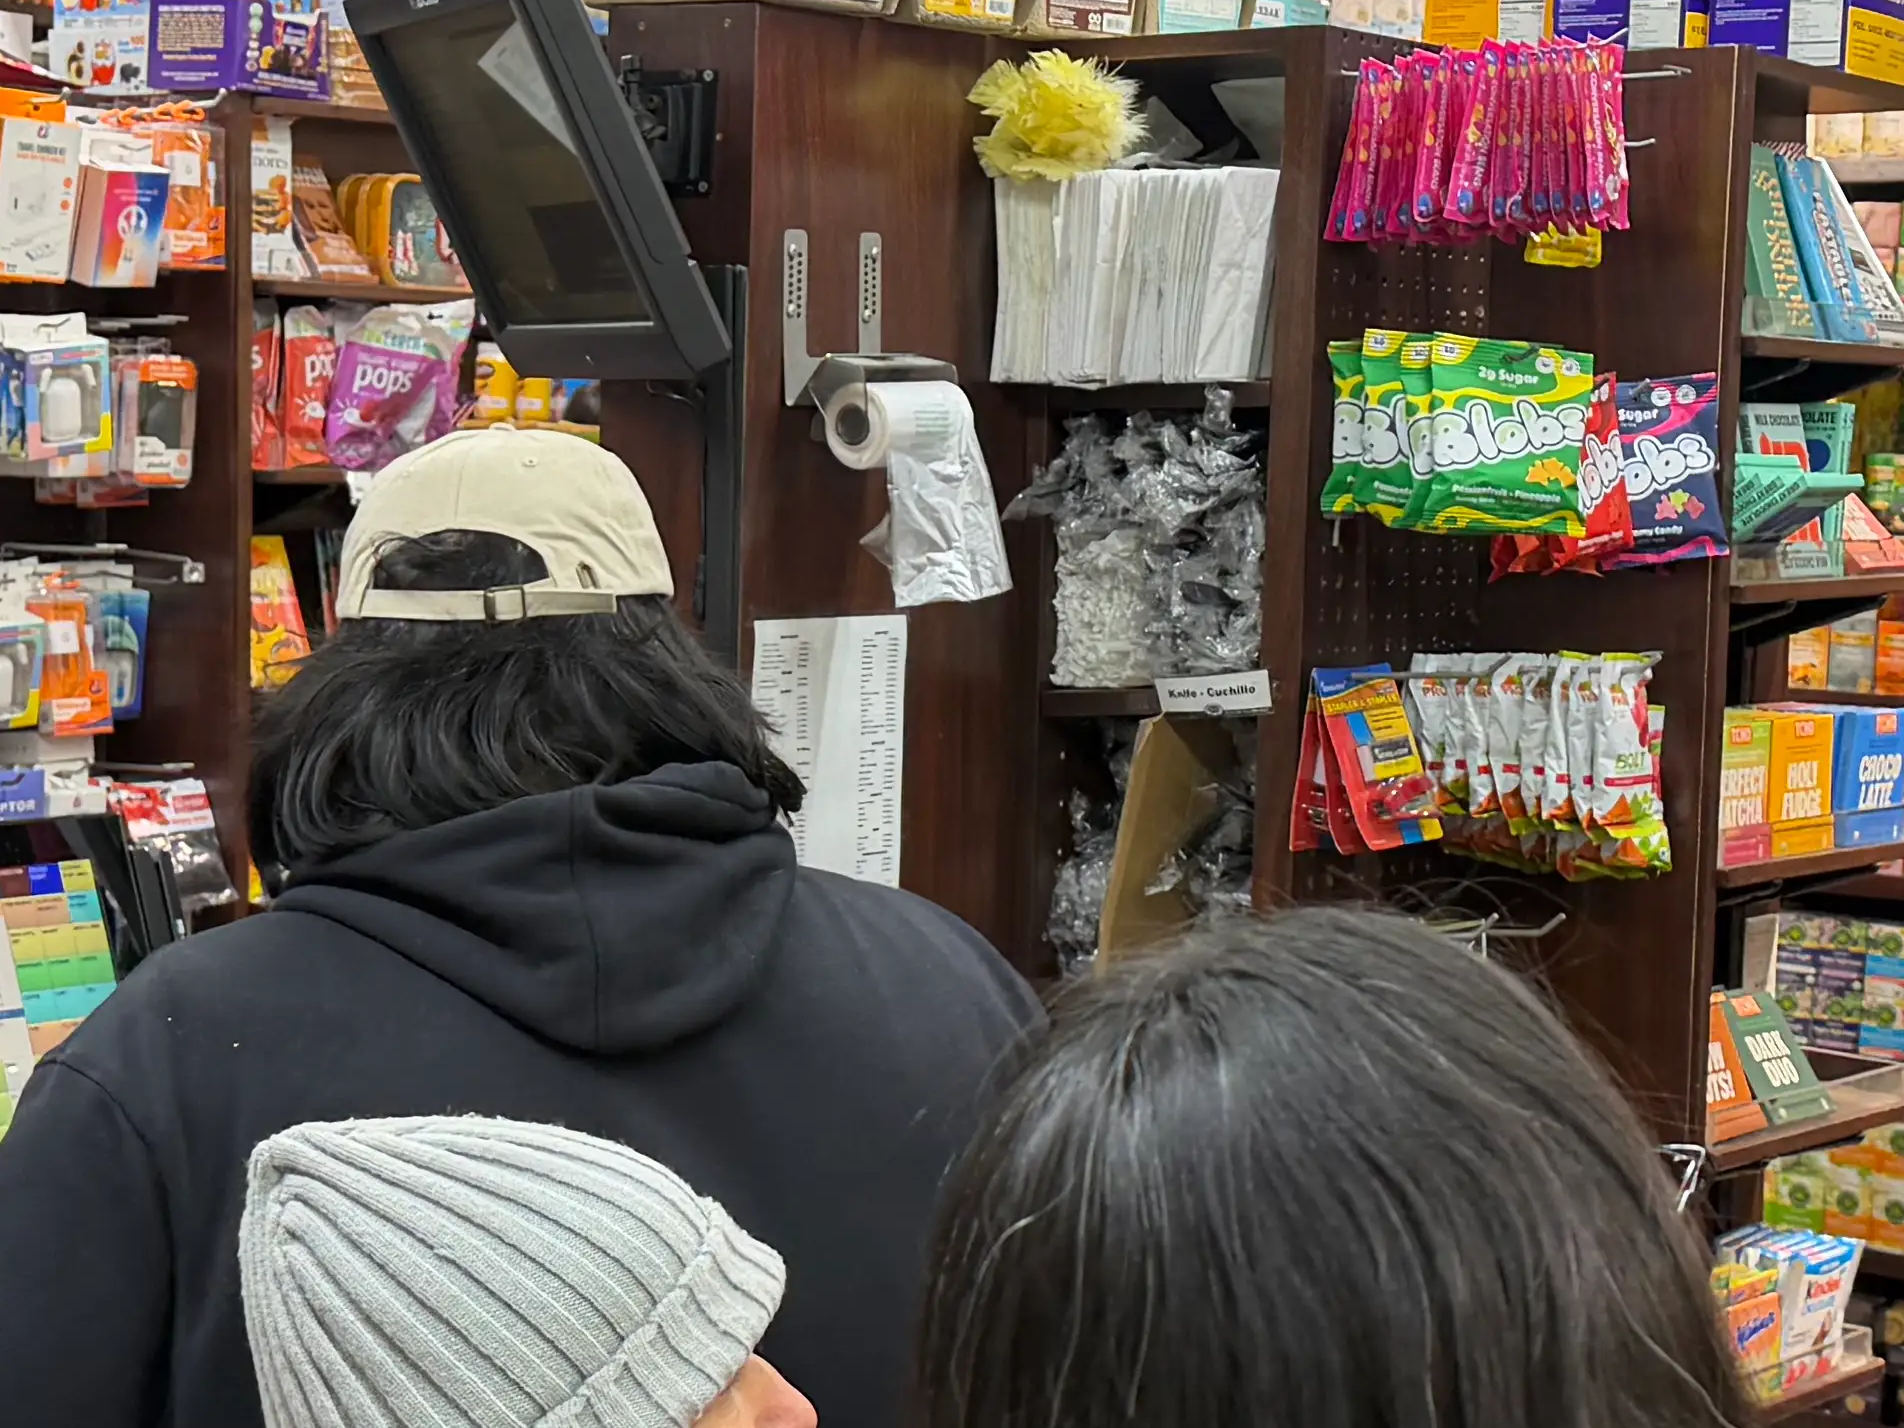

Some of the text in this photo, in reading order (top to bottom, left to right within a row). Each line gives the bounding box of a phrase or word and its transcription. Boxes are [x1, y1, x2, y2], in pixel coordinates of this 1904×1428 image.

[351, 363, 415, 398] pops
[1477, 365, 1541, 386] 2g Sugar
[1430, 398, 1589, 474] Blobs
[1653, 524, 1684, 537] Candy
[1206, 683, 1257, 699] Cuchillo
[1787, 761, 1820, 790] HOLY
[1858, 753, 1903, 783] CHOCO
[1781, 788, 1823, 820] FUDGE
[1744, 1030, 1791, 1062] DARK
[1762, 1056, 1800, 1088] DUO
